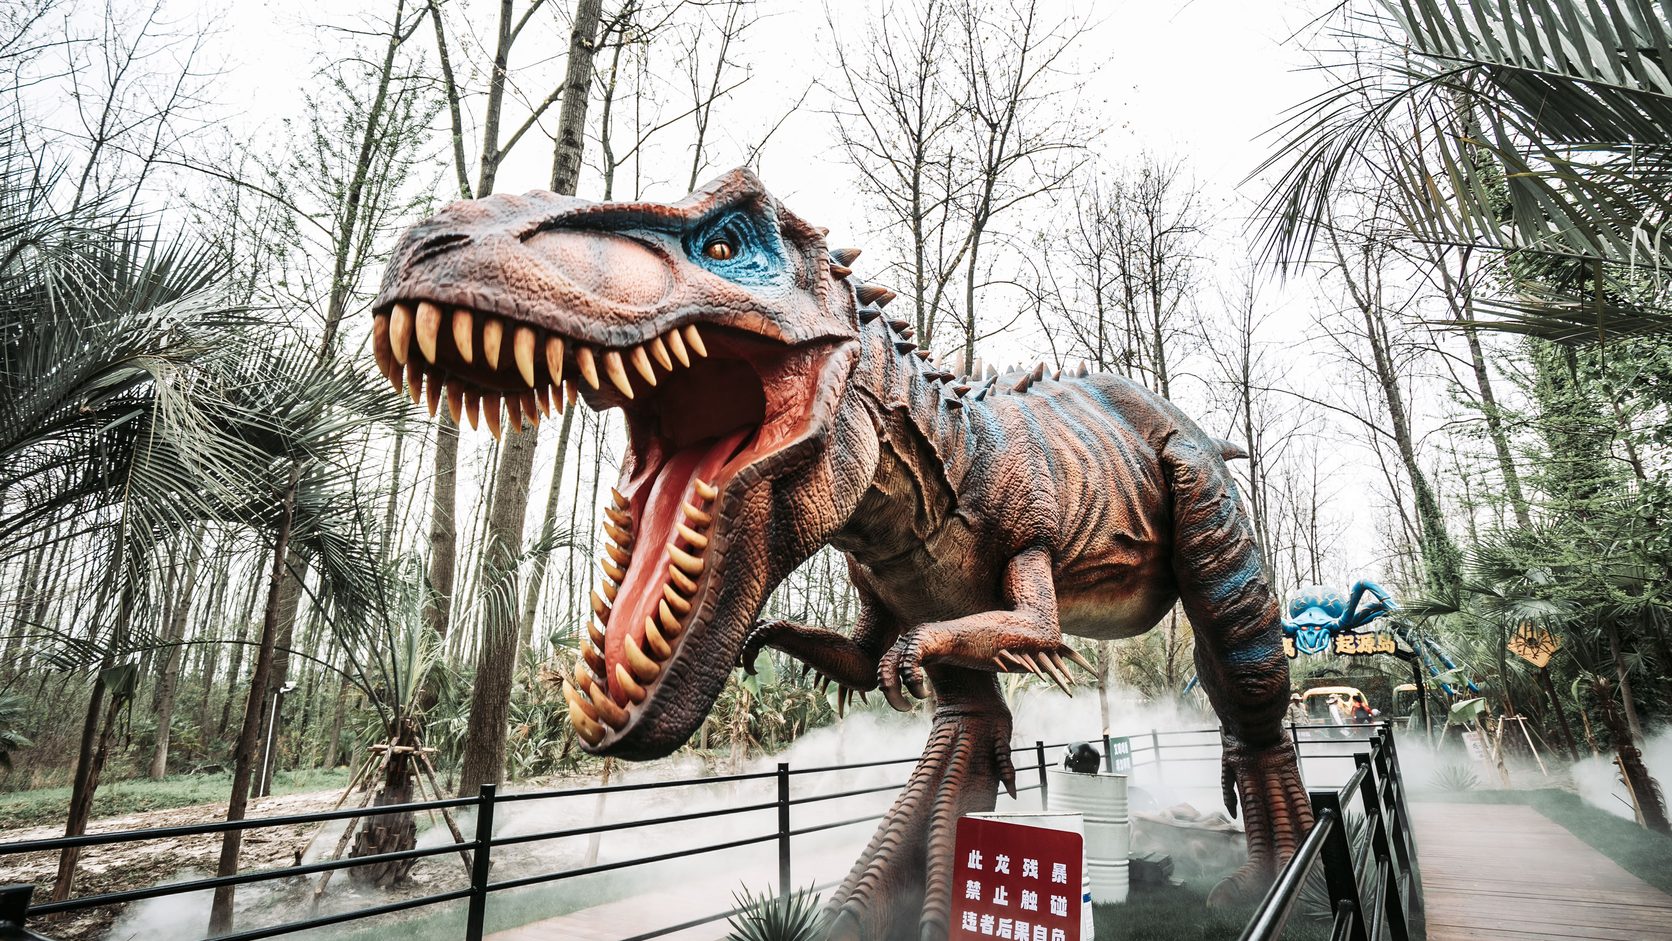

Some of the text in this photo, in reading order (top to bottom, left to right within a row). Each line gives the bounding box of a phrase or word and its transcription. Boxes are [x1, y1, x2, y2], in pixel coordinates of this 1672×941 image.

[1335, 633, 1395, 653] 起源岛
[967, 849, 1068, 884] 此龙残暴
[966, 880, 1067, 917] 禁止触碰
